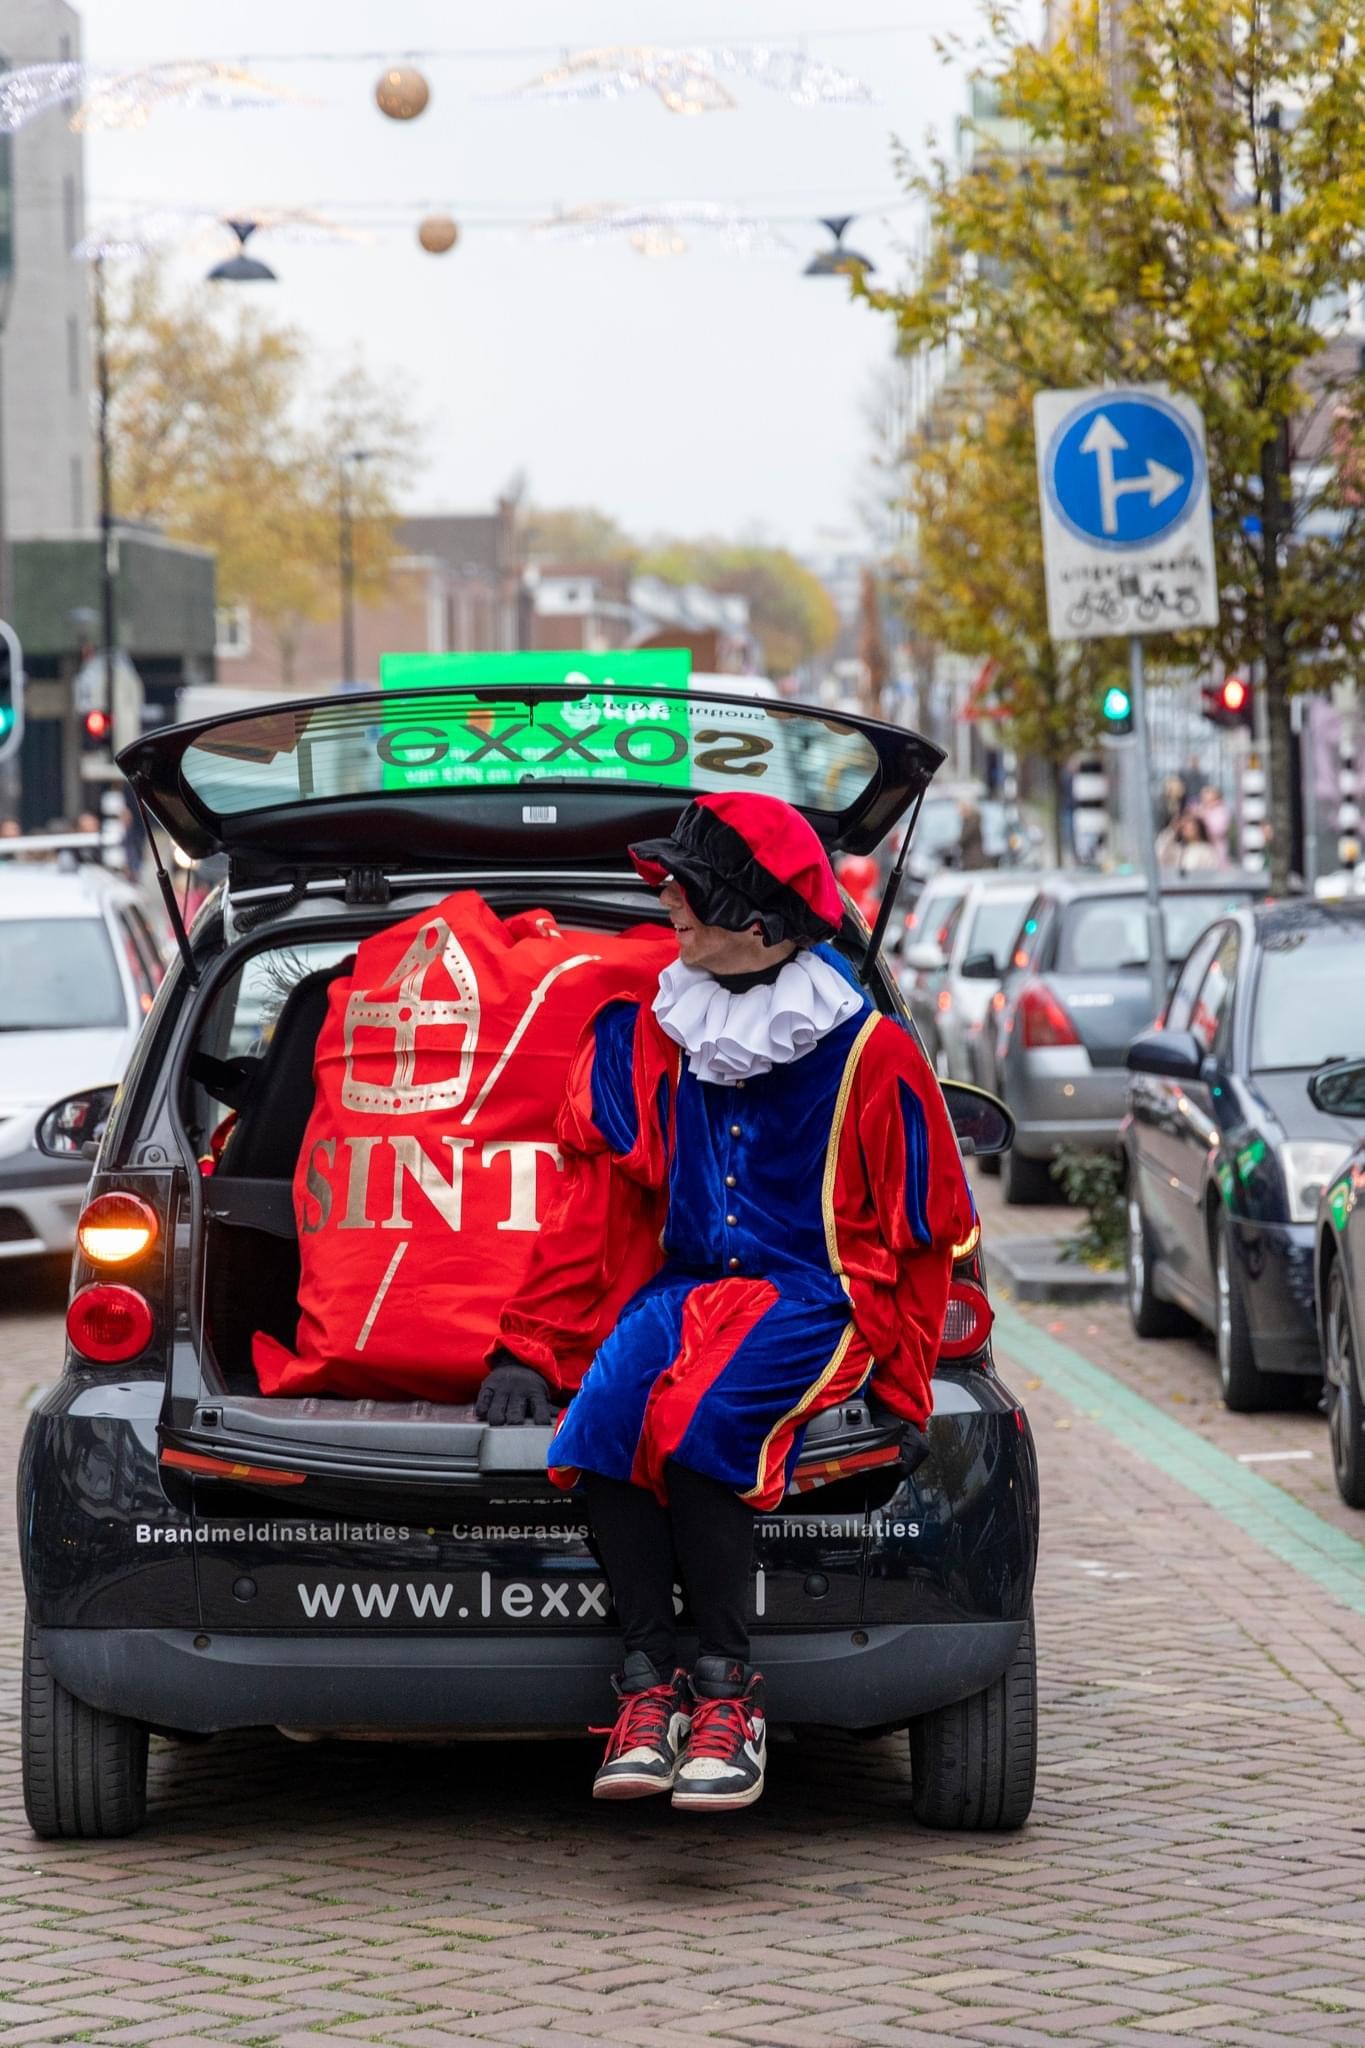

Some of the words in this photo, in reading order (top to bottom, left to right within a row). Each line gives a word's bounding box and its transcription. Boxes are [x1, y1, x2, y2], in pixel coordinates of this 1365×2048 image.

[303, 1136, 564, 1234] SINT
[136, 1523, 410, 1543] Brandmeldinstallaties
[452, 1523, 594, 1543] Camerasys
